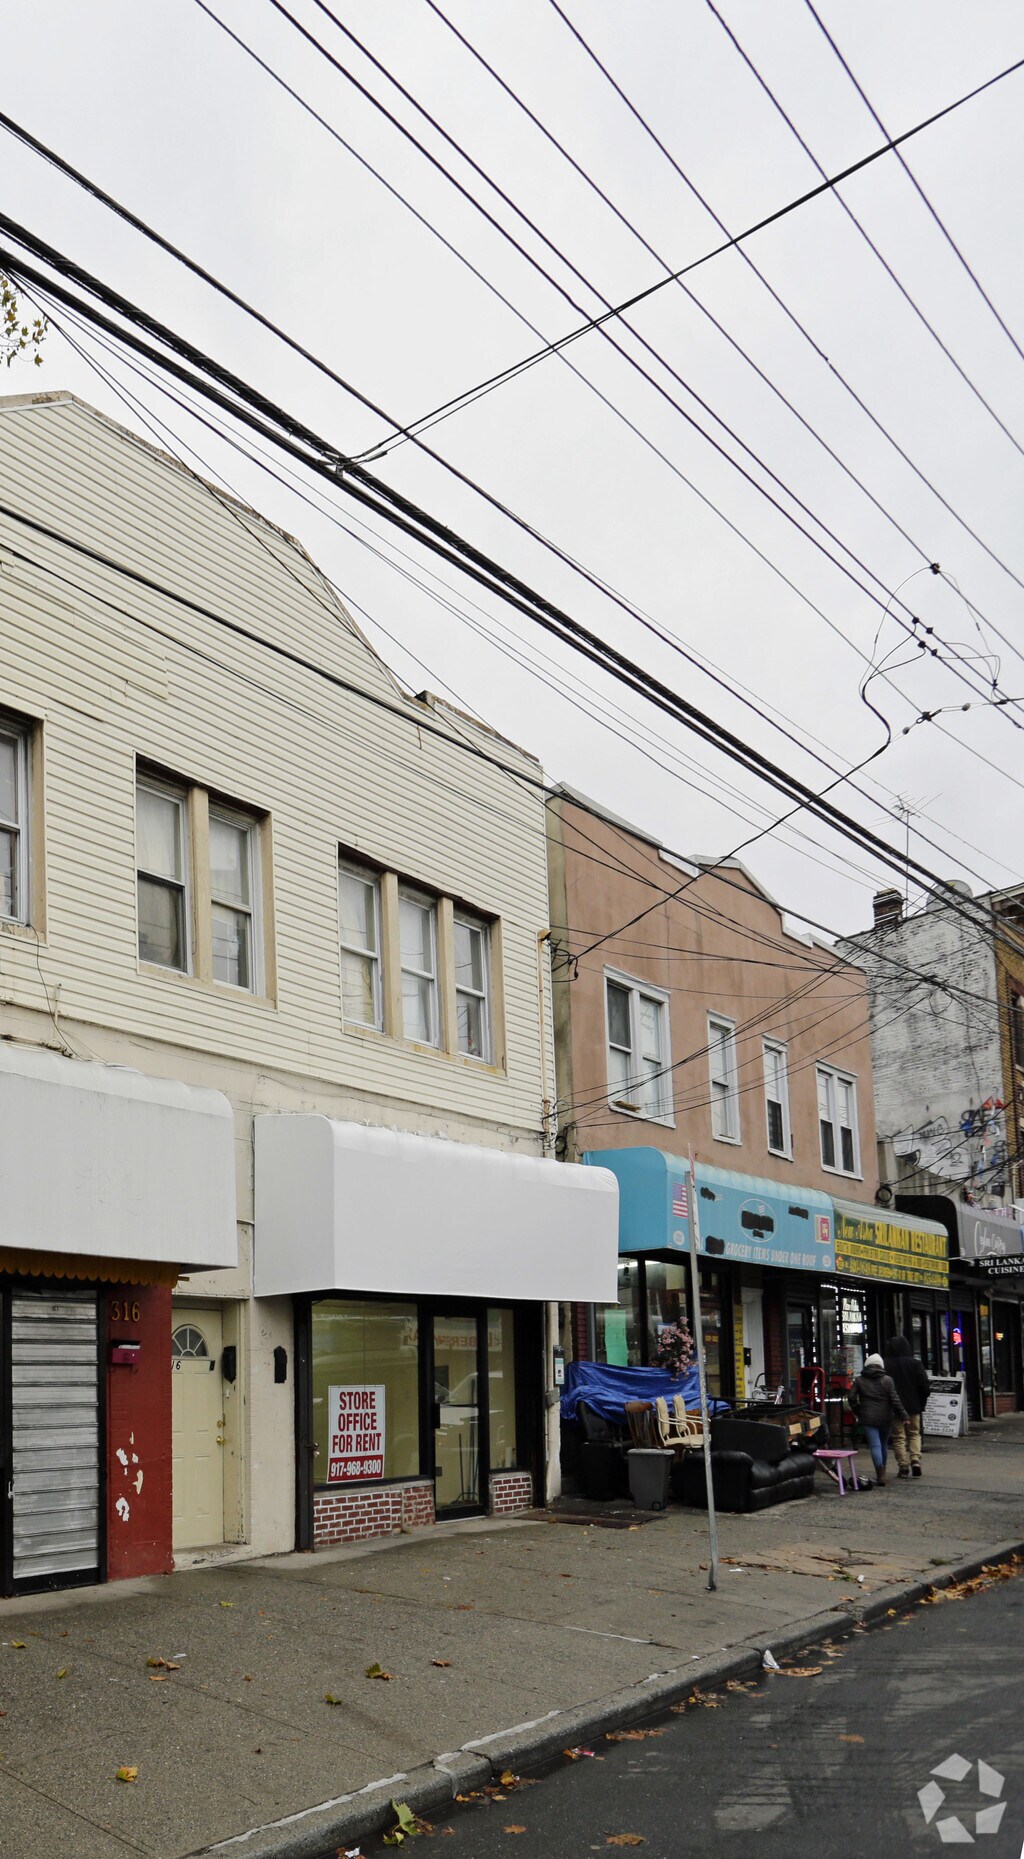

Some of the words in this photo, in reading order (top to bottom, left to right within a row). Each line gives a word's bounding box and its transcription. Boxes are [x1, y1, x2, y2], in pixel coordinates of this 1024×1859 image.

[725, 1242, 752, 1259] GROCERY
[753, 1246, 770, 1261] ITEMS
[771, 1249, 790, 1264] UNDER
[791, 1251, 802, 1265] ONE
[803, 1254, 816, 1267] ROOF
[979, 1259, 994, 1268] SRI
[988, 1265, 1024, 1275] CUISINE
[111, 1301, 141, 1322] 316
[339, 1391, 376, 1410] STORE
[338, 1412, 377, 1432] OFFICE
[332, 1434, 353, 1454] FOR
[355, 1433, 382, 1453] RENT
[330, 1459, 382, 1477] 917-968-9300
